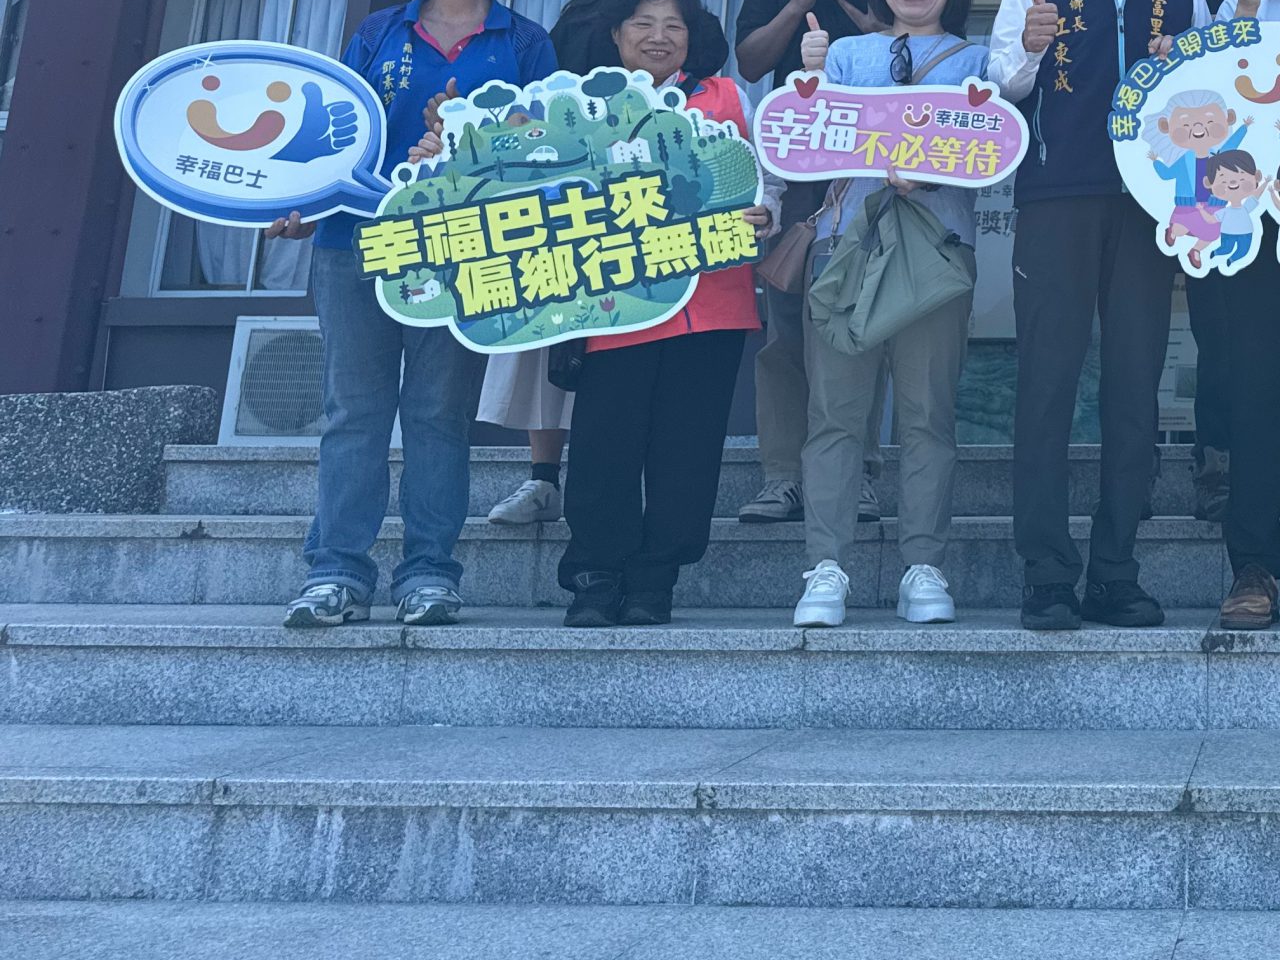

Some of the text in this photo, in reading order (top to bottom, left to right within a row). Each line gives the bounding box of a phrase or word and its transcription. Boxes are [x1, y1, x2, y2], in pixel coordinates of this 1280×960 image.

[761, 98, 864, 159] 幸福
[935, 107, 1004, 132] 幸福巴士
[174, 153, 268, 190] 幸福巴士
[856, 130, 1002, 175] 不必等待
[359, 177, 667, 277] 幸福巴士來
[455, 208, 758, 316] 偏鄉行無礙
